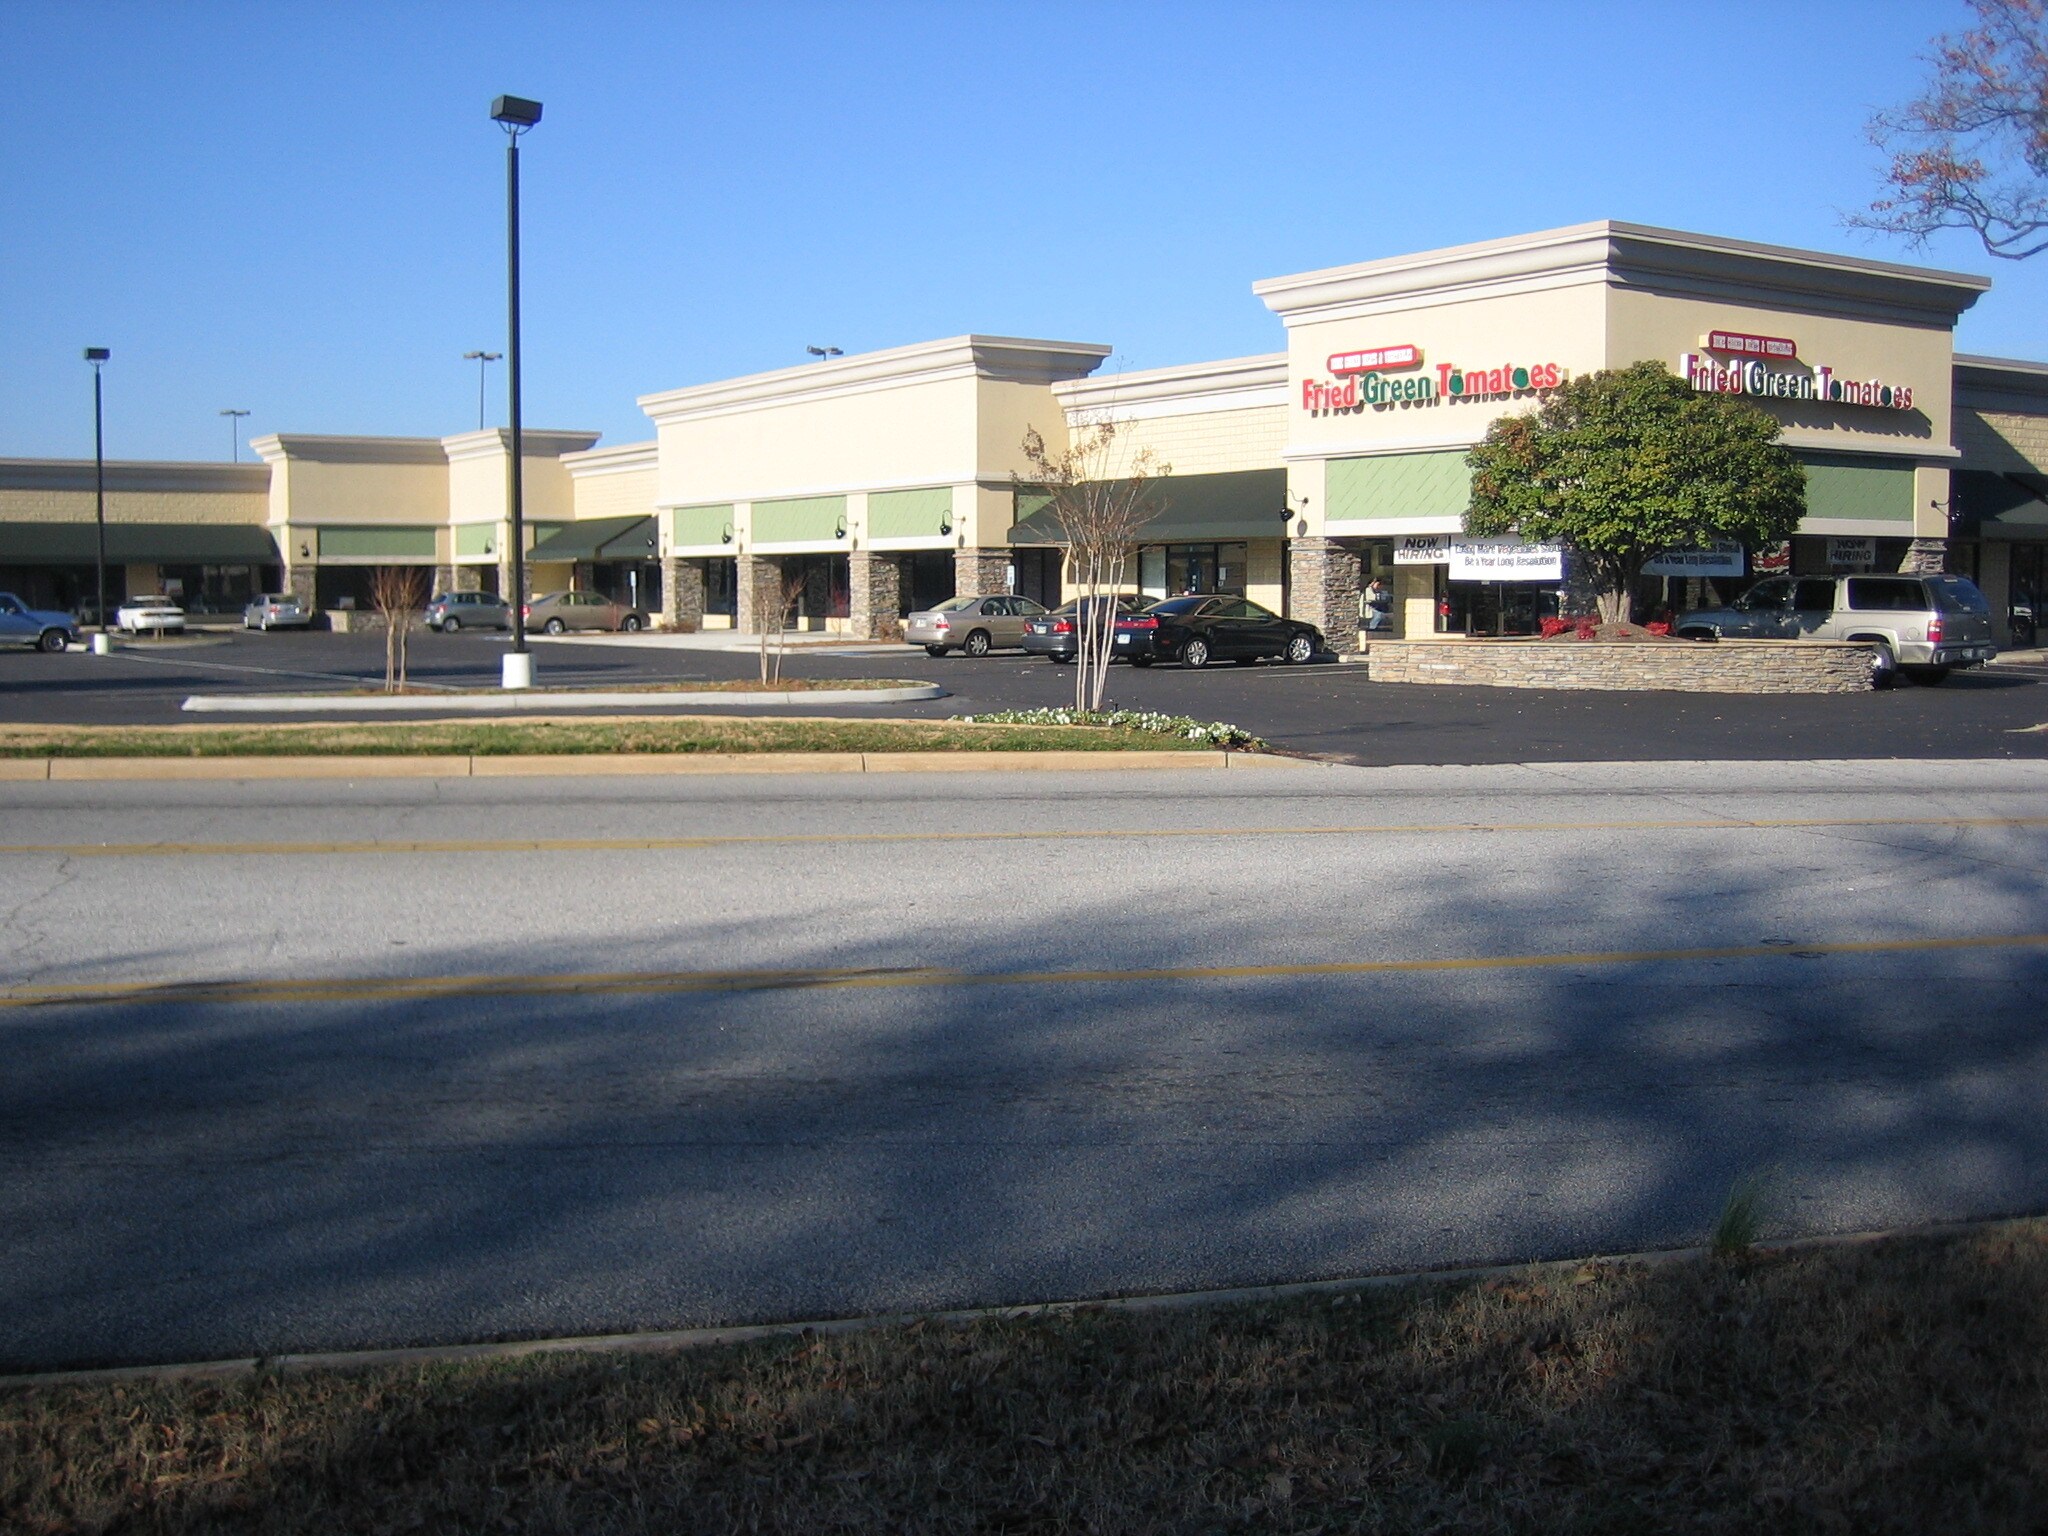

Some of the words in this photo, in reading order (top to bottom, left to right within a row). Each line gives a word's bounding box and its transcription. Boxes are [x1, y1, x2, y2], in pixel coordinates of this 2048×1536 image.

[1302, 373, 1357, 410] Fried
[1363, 371, 1431, 404] Green
[1436, 362, 1562, 397] Tomatoes
[1682, 354, 1743, 394] Fried
[1746, 361, 1813, 400] Green
[1814, 365, 1914, 410] Tomatoes
[1405, 537, 1439, 548] NOW
[1837, 539, 1866, 549] NOW
[1398, 549, 1444, 559] HIRING
[1829, 550, 1872, 560] HIRING
[1481, 556, 1496, 566] Year
[1497, 556, 1515, 567] Long
